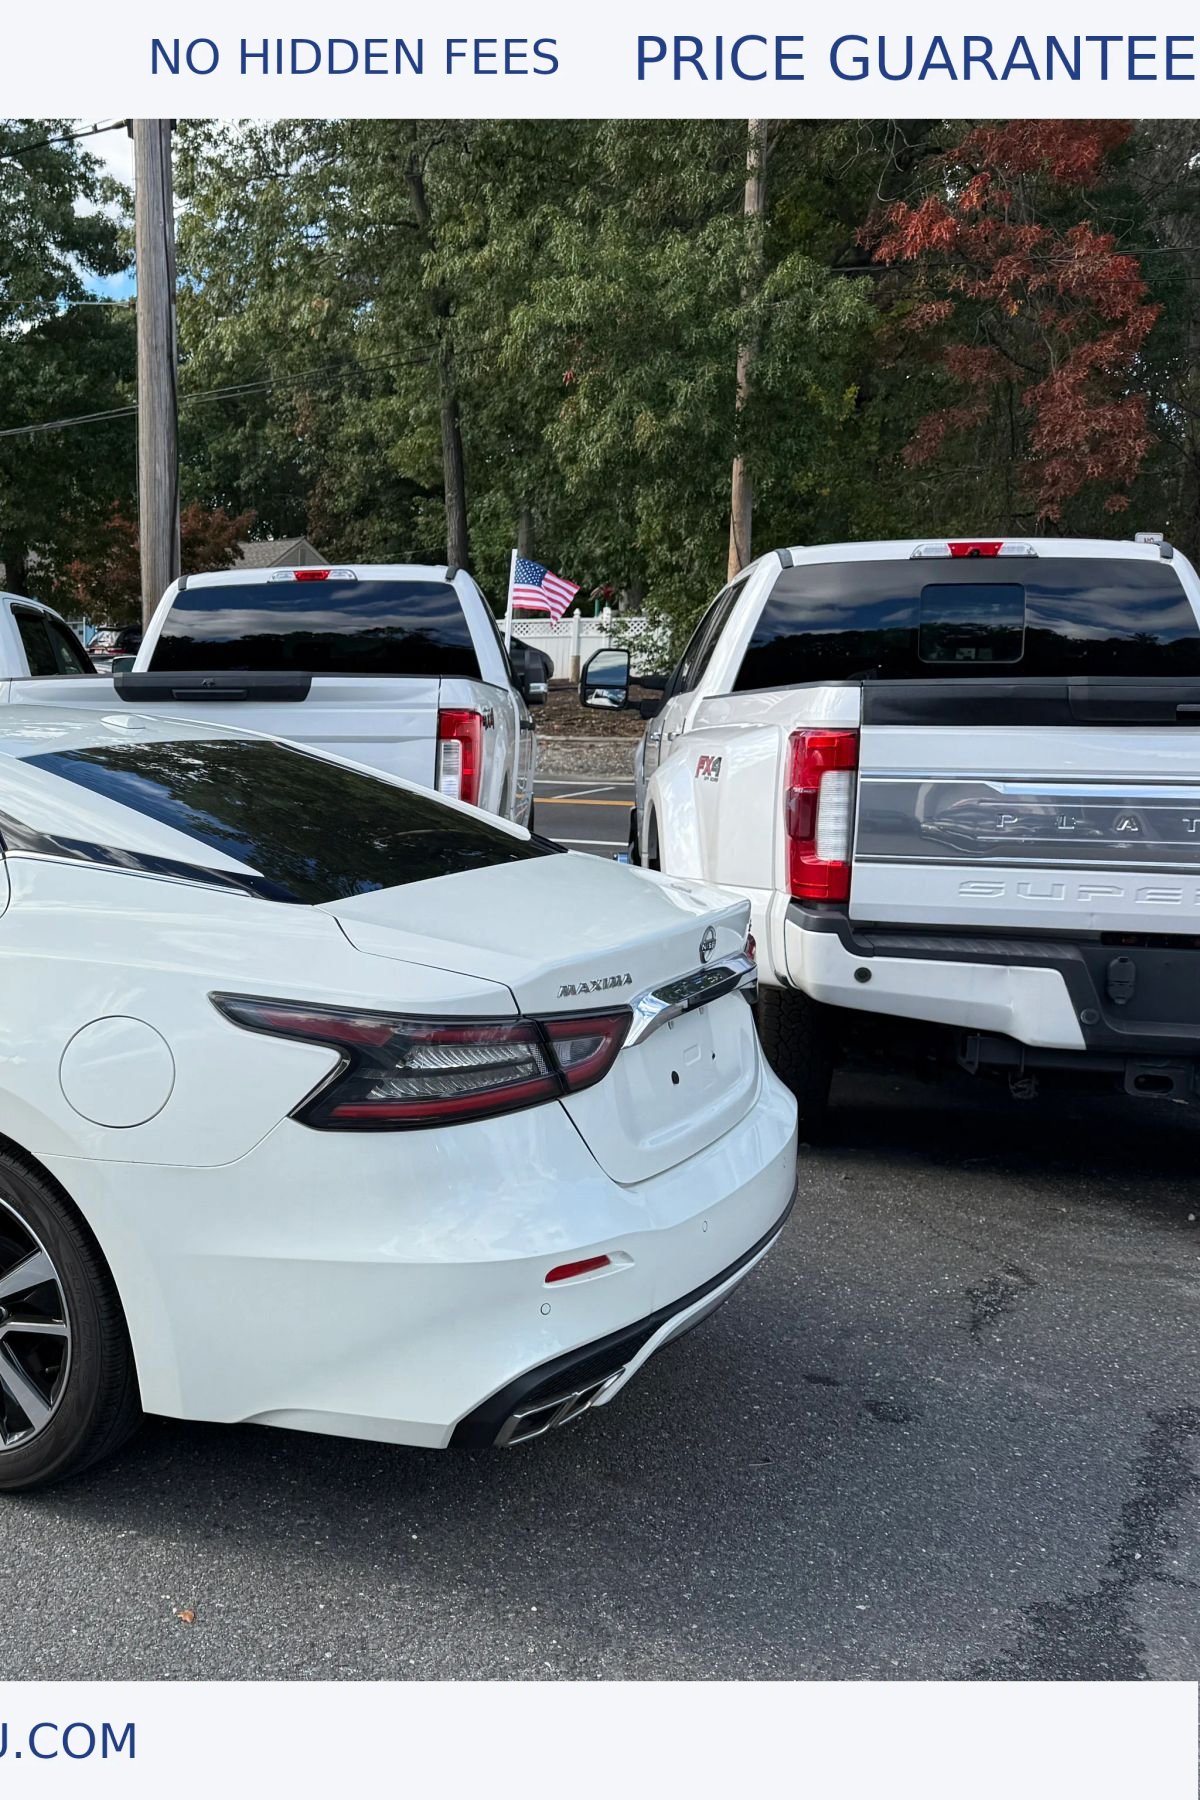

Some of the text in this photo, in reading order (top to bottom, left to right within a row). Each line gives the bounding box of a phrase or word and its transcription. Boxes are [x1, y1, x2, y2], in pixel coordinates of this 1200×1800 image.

[695, 755, 722, 778] FX4
[958, 880, 1200, 906] SUPE
[557, 973, 633, 998] MAXIMA
